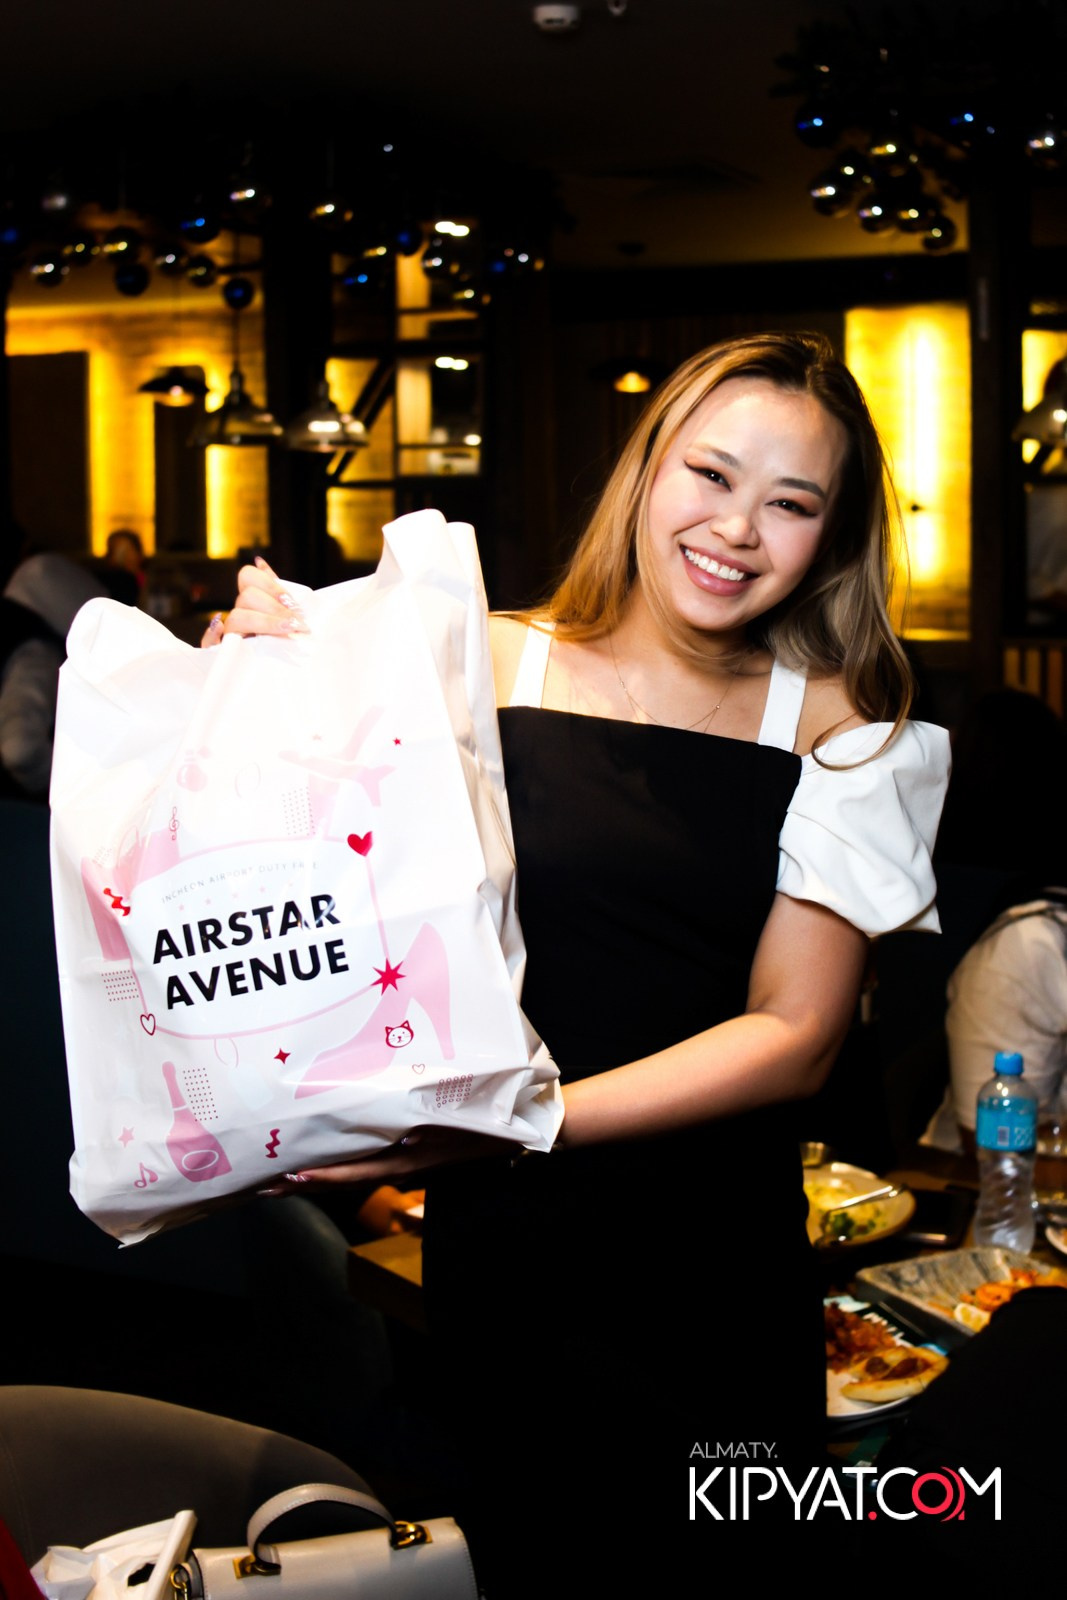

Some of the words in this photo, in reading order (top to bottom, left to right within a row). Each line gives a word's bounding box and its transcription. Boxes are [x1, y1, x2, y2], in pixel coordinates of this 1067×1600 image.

[161, 879, 205, 904] INCHEON
[258, 863, 287, 873] DUTY
[292, 860, 319, 870] FRE
[153, 894, 341, 965] AIRSTAR
[166, 938, 349, 1010] AVENUE
